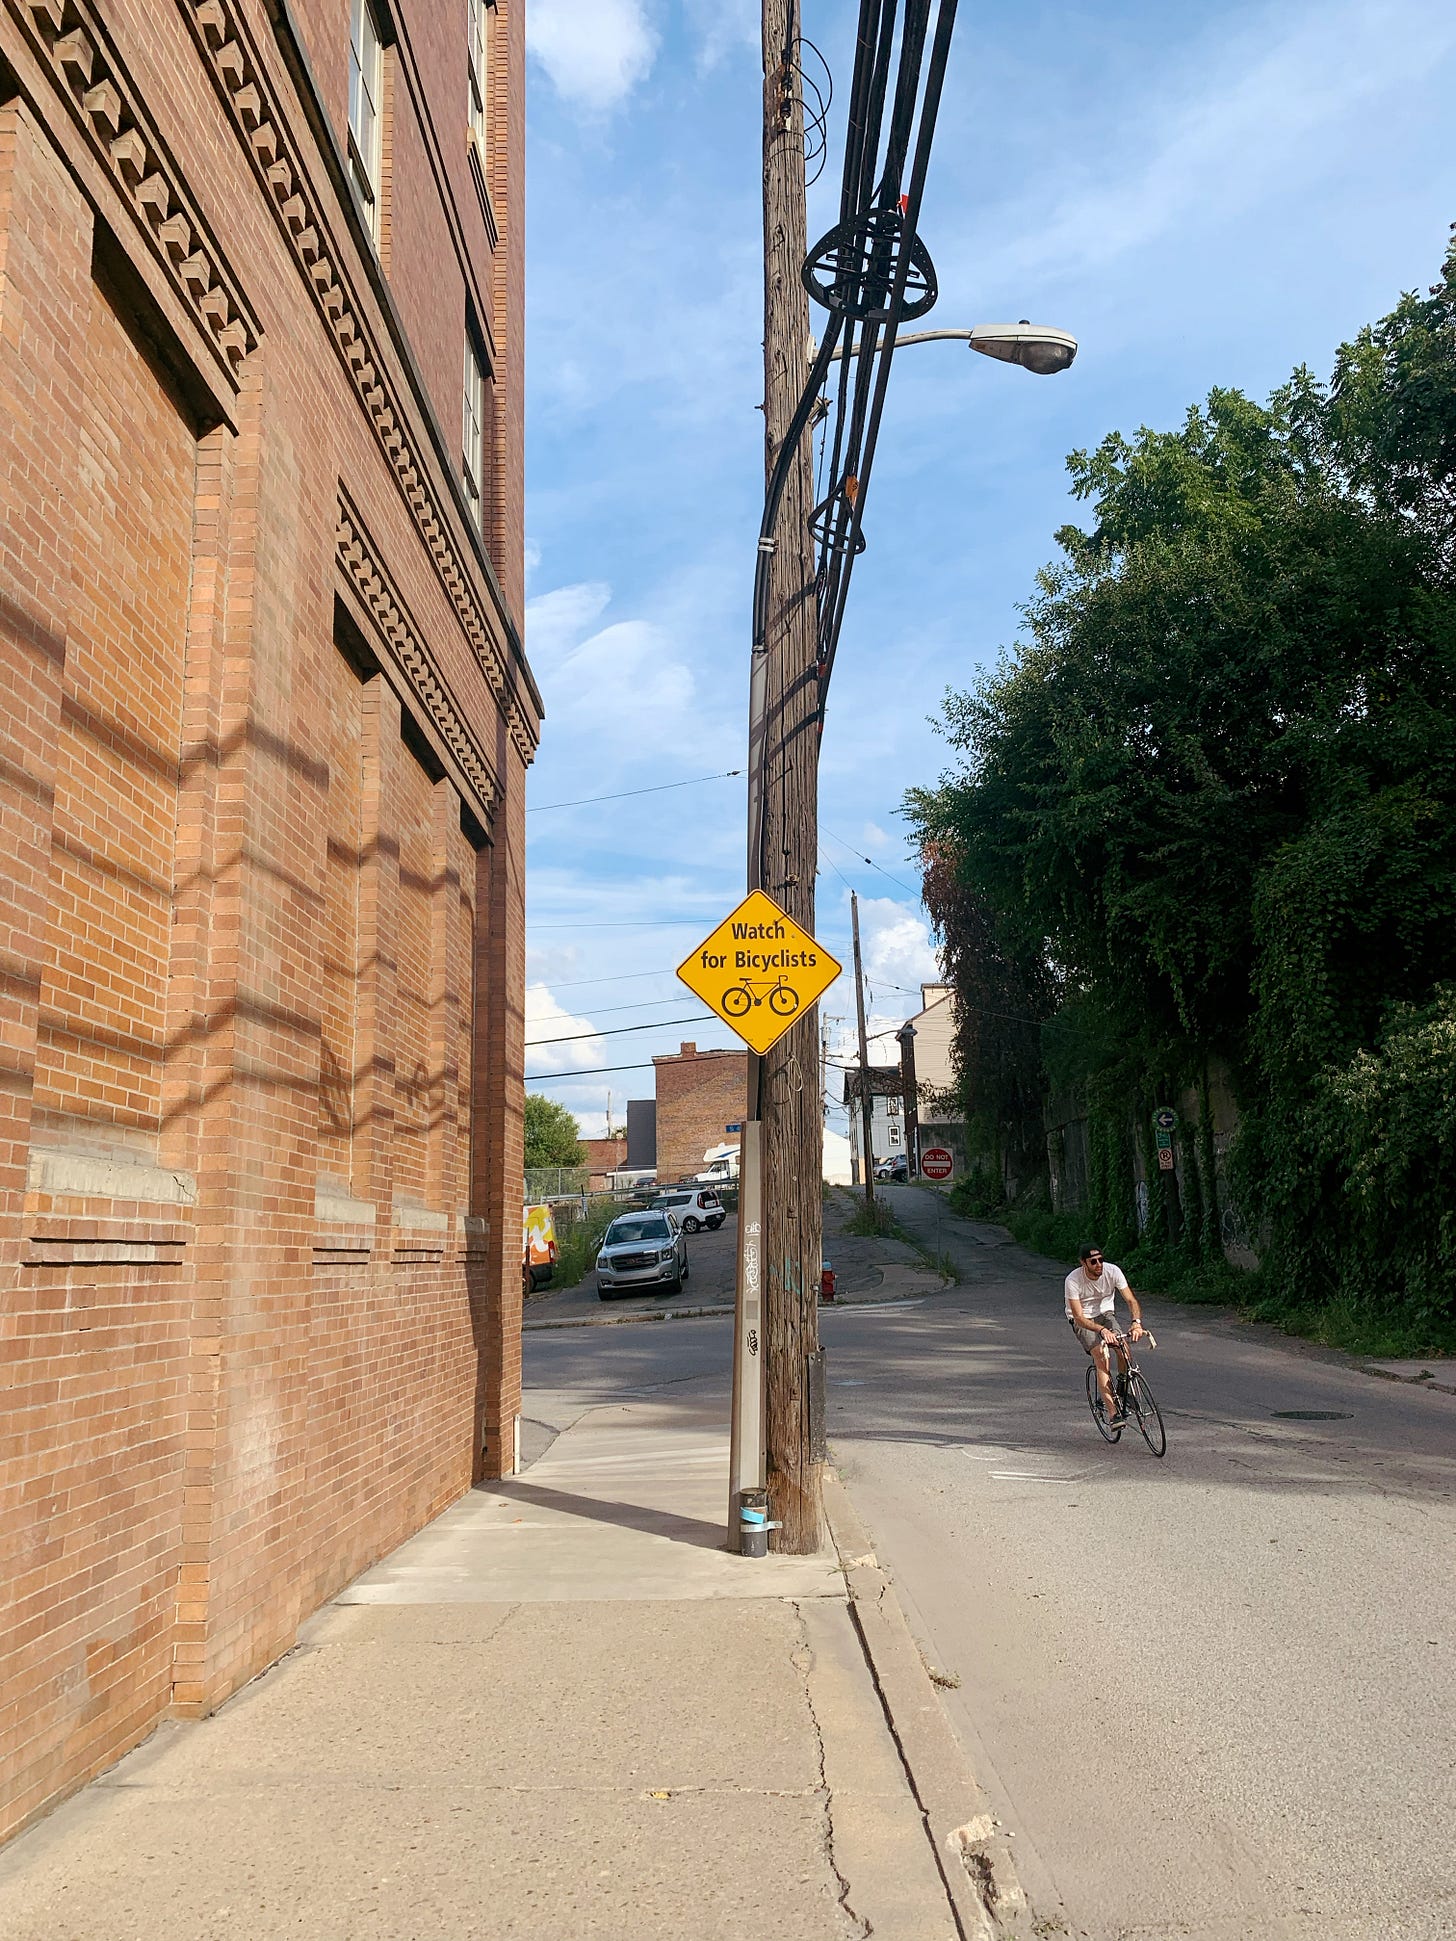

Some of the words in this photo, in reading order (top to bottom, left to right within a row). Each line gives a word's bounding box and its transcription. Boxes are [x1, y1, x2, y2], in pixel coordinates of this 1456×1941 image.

[731, 922, 785, 939] Watch
[700, 950, 727, 969] for
[735, 949, 817, 972] Bicyclists
